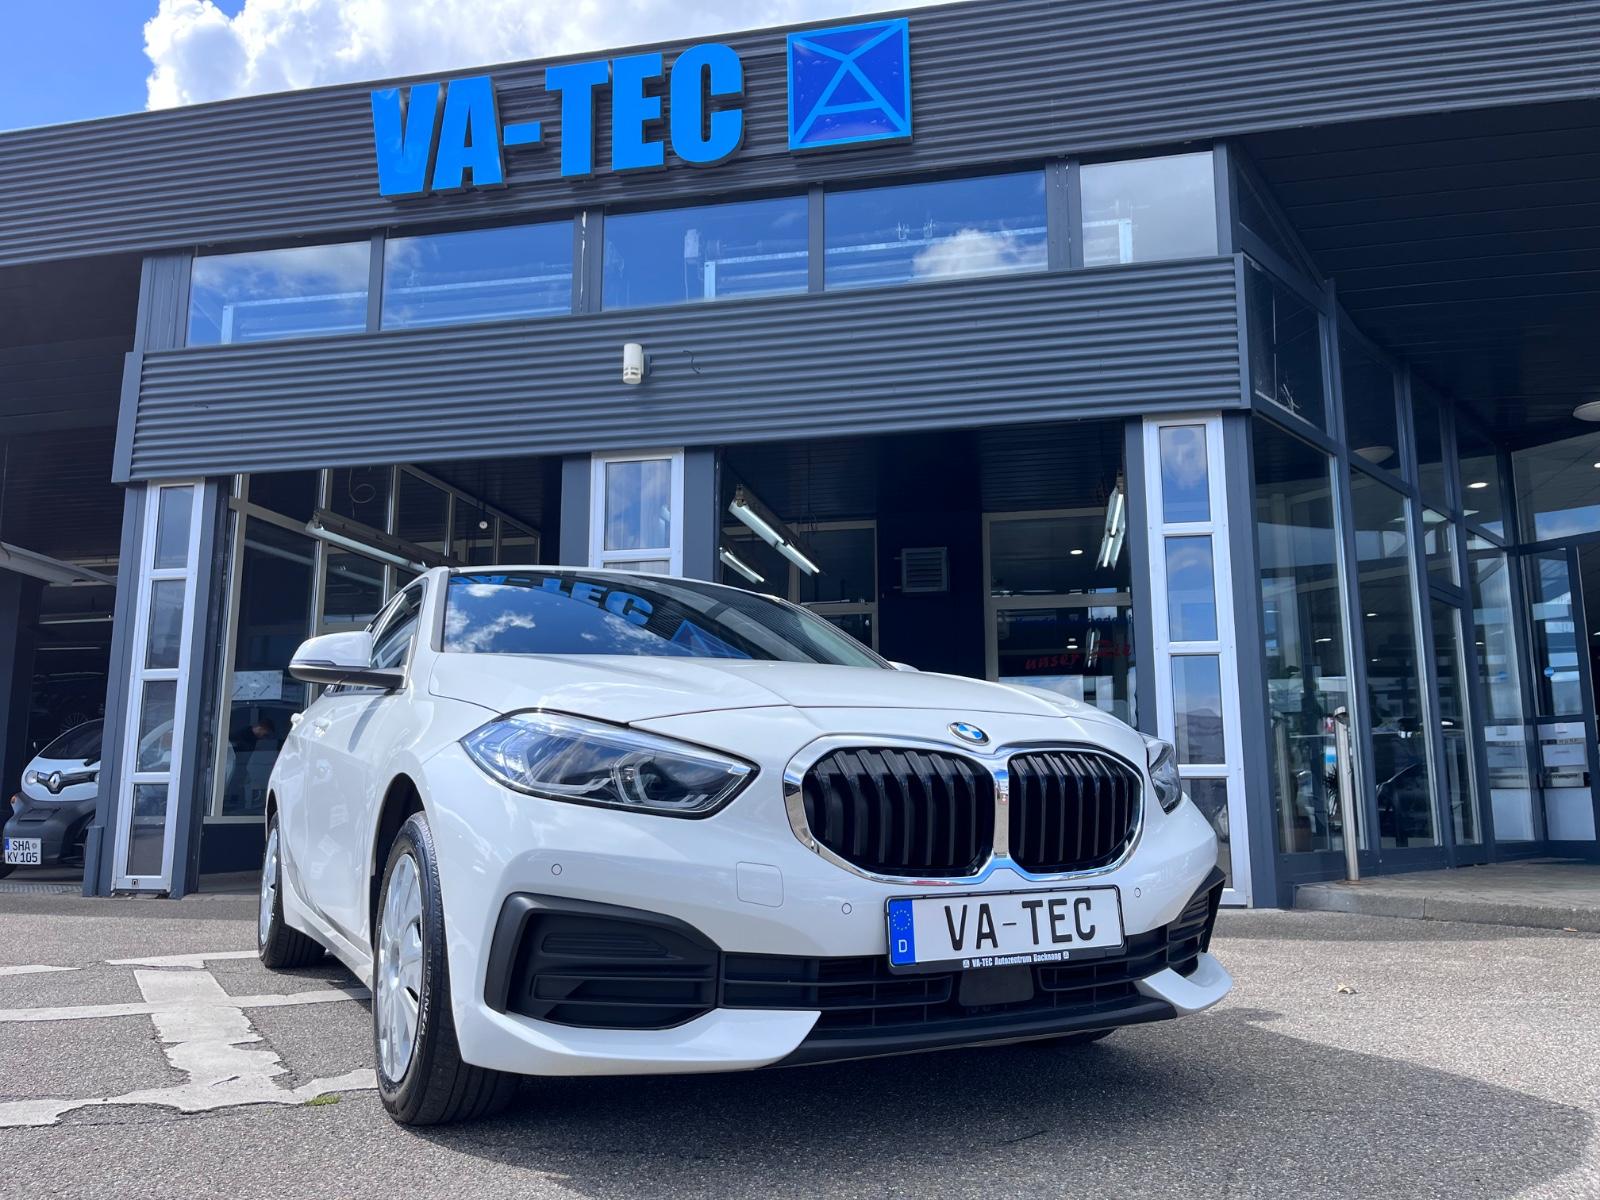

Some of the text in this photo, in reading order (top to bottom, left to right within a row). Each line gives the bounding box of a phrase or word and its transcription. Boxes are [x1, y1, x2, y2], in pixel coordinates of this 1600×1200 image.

[371, 43, 744, 196] VA-TEC
[12, 840, 30, 851] SHA
[7, 851, 38, 863] KY 105
[944, 897, 1096, 951] VA-TEC
[898, 939, 908, 953] D
[972, 957, 993, 968] VA-TEC
[994, 954, 1032, 966] Autozentrum
